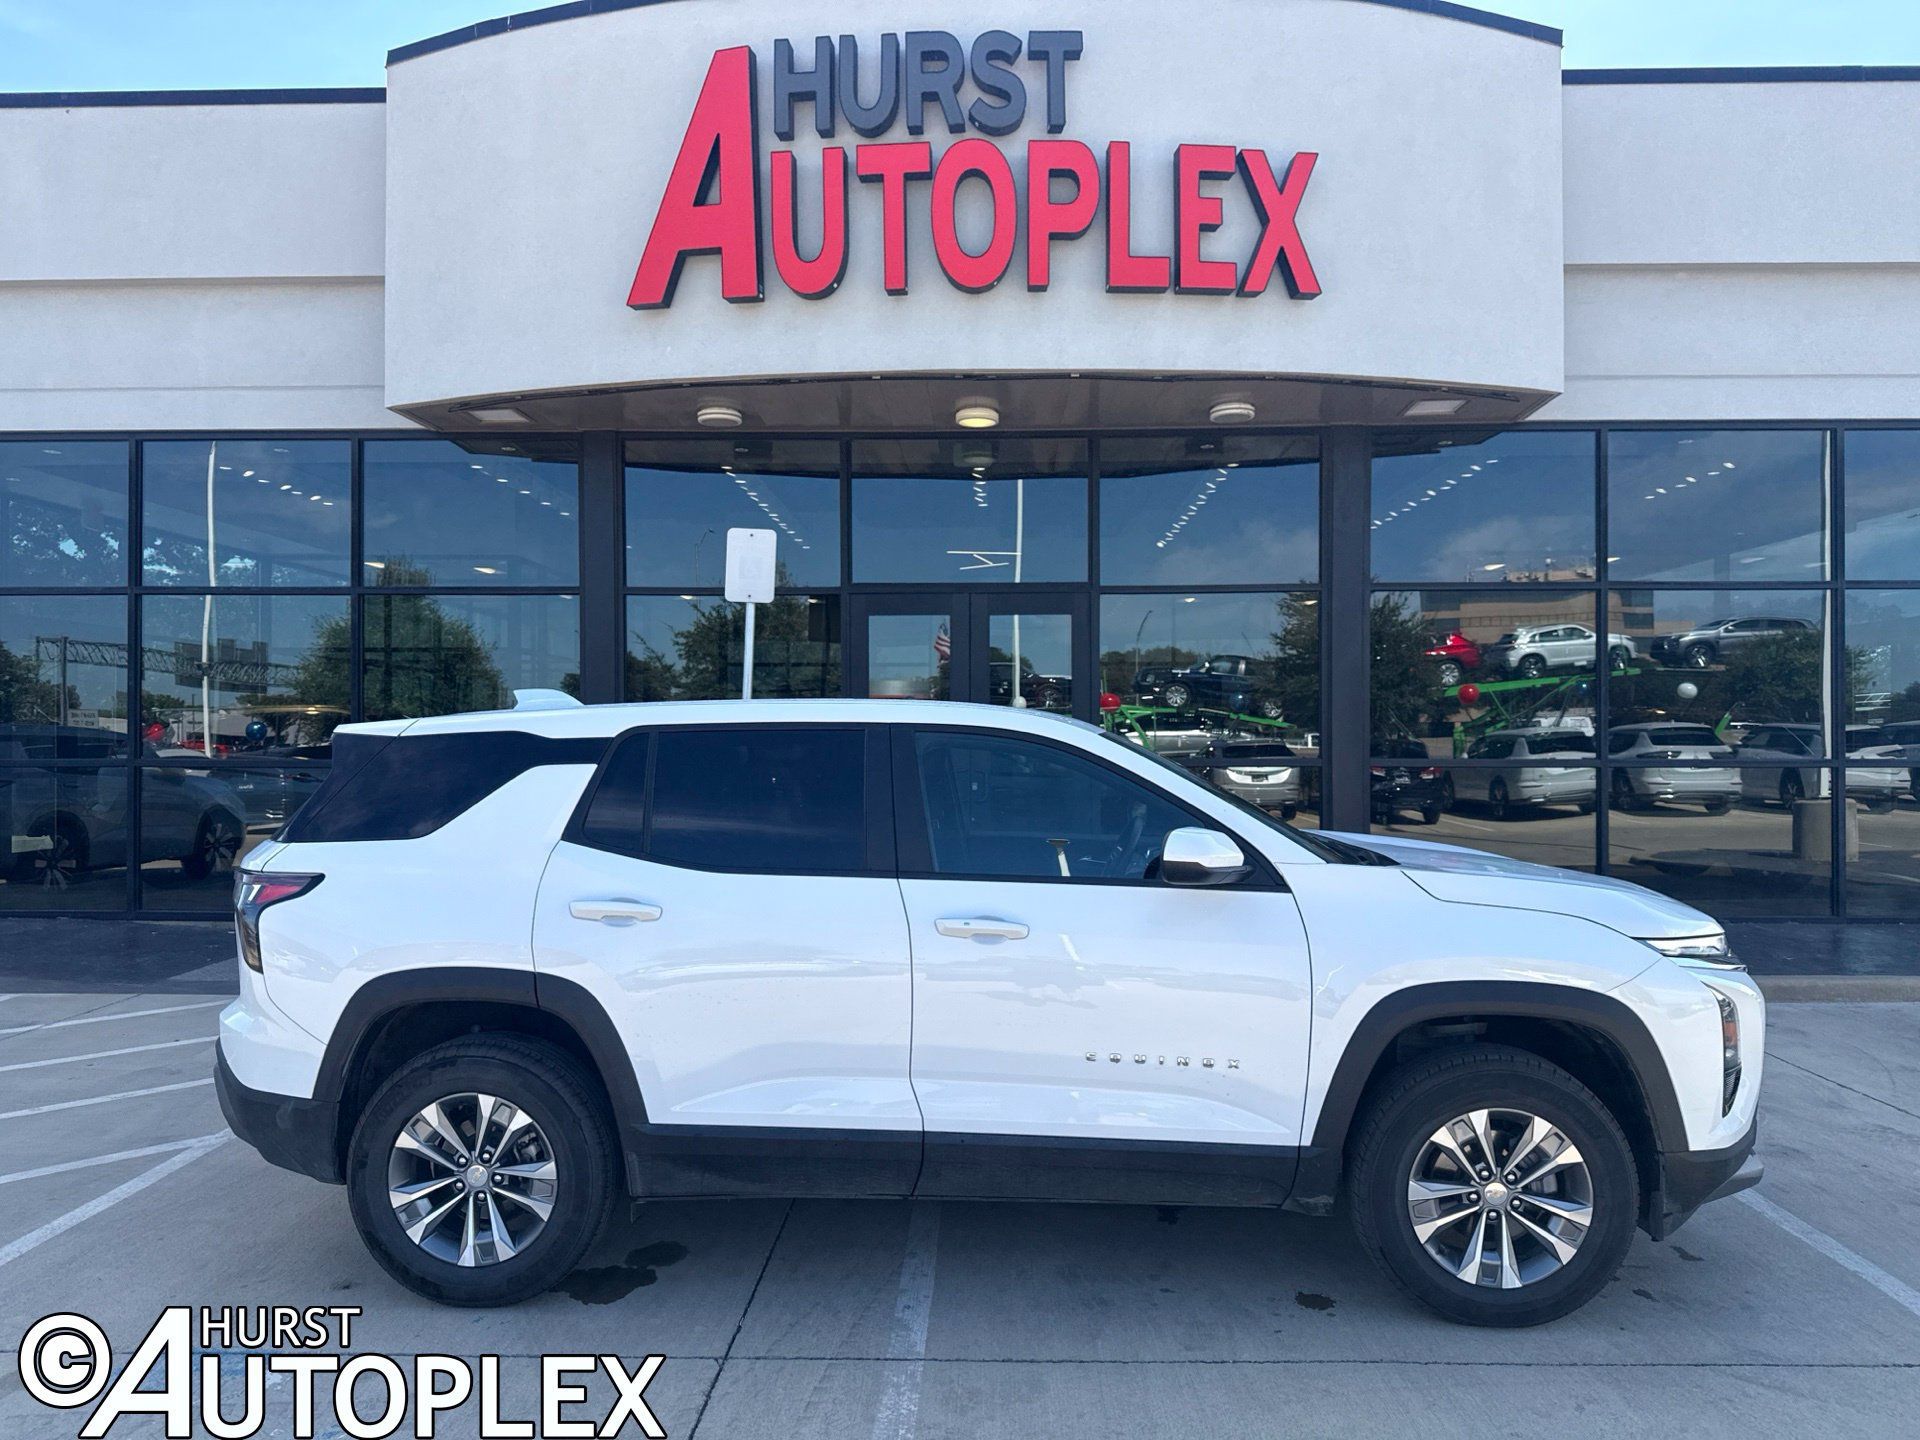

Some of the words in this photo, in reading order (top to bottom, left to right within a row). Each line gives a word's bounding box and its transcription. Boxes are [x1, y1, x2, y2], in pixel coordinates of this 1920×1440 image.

[773, 30, 1084, 141] HURST
[626, 45, 1321, 310] AUTOPLEX
[1085, 1052, 1239, 1069] EQUINOX
